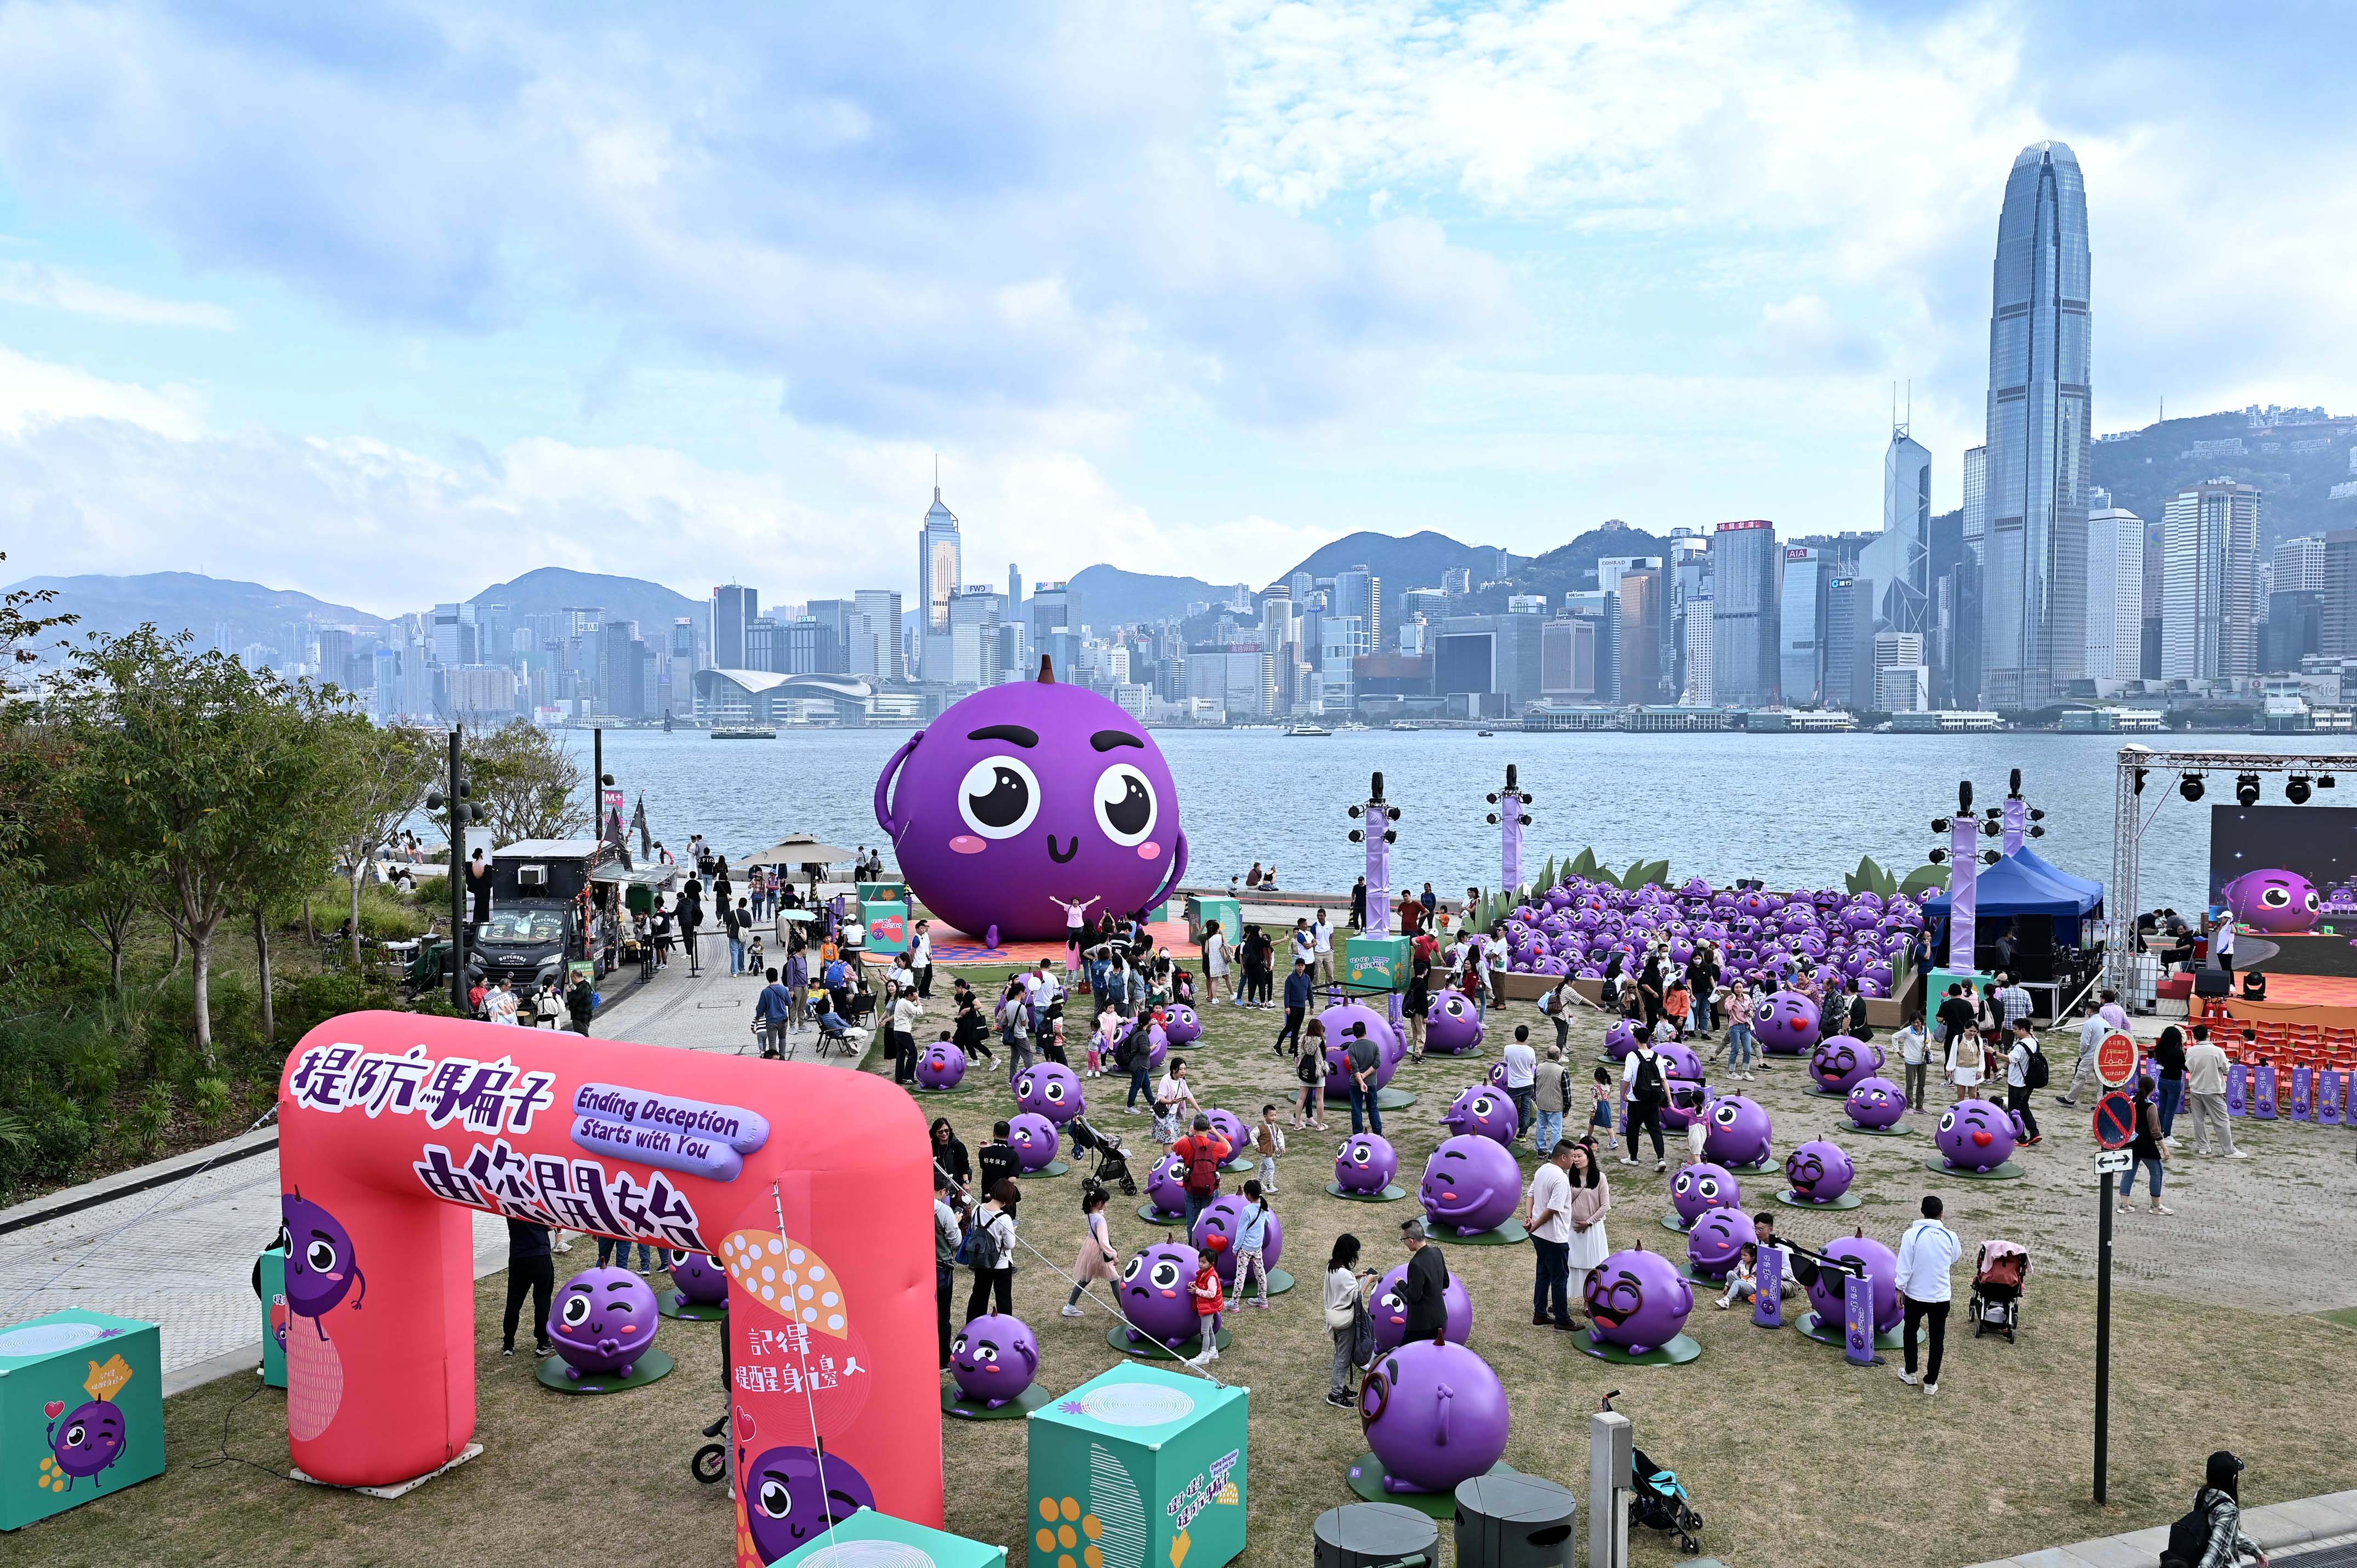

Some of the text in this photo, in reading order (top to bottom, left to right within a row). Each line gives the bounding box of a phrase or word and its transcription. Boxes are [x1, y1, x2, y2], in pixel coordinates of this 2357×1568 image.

[2319, 682, 2338, 697] ifc
[293, 1047, 550, 1128] 提防騙子
[577, 1087, 739, 1137] Ending Deception
[580, 1118, 711, 1160] Starts with You
[748, 1323, 812, 1355] 記得
[735, 1354, 866, 1394] 提醒身邊人
[1211, 1452, 1238, 1470] Ending Deception
[1168, 1475, 1203, 1514] 提子 提子
[1177, 1470, 1229, 1528] 提防騙子
